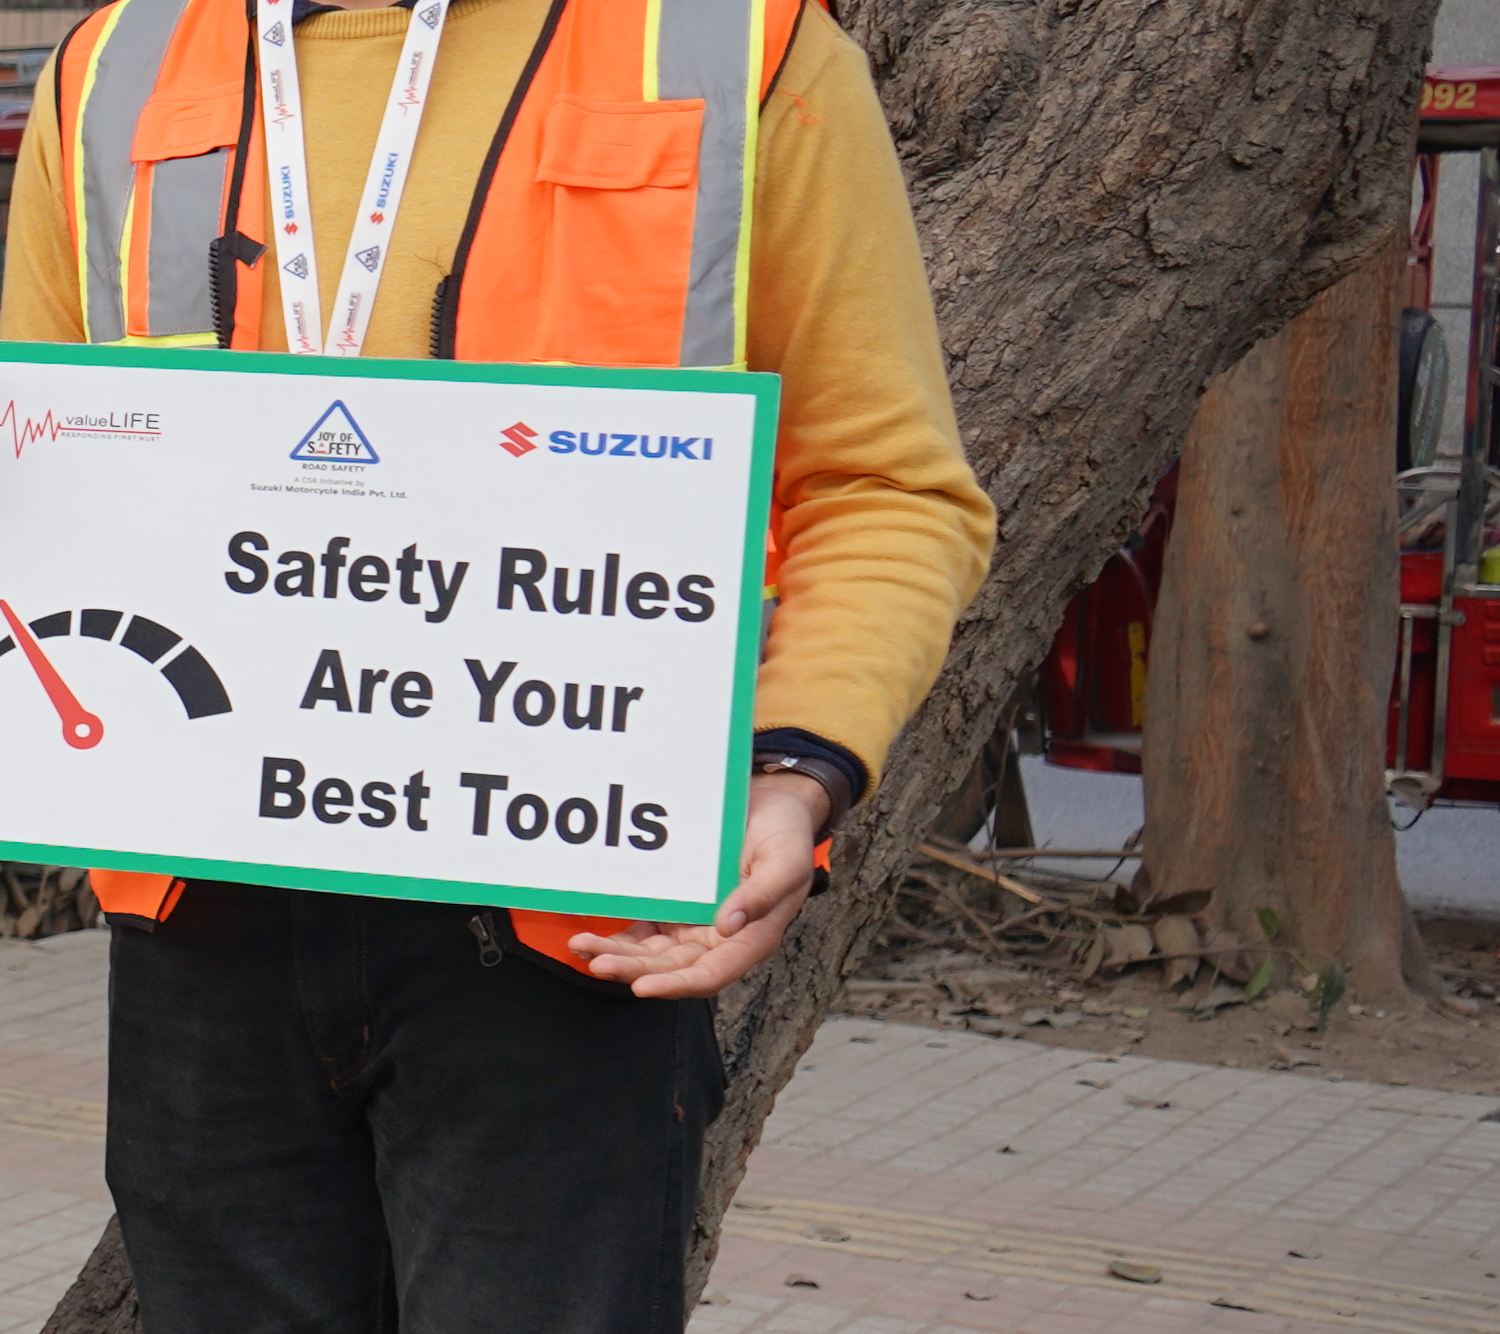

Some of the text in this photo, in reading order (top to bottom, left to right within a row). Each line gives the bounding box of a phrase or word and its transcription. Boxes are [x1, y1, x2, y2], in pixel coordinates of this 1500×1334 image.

[280, 165, 295, 219] SUZUKI
[376, 152, 399, 208] SUZUKI
[60, 432, 112, 440] RESPONDING
[65, 412, 160, 429] valueLIFE
[317, 431, 353, 442] JOY OF
[547, 429, 713, 461] SUZUKI
[302, 463, 365, 473] ROAD SAFETY
[250, 483, 408, 499] Suzuki Motorcycle India Pvt. Ltd.
[224, 531, 716, 624] Safety Rules
[299, 649, 644, 733] Are Your
[258, 757, 670, 851] Best Tools
